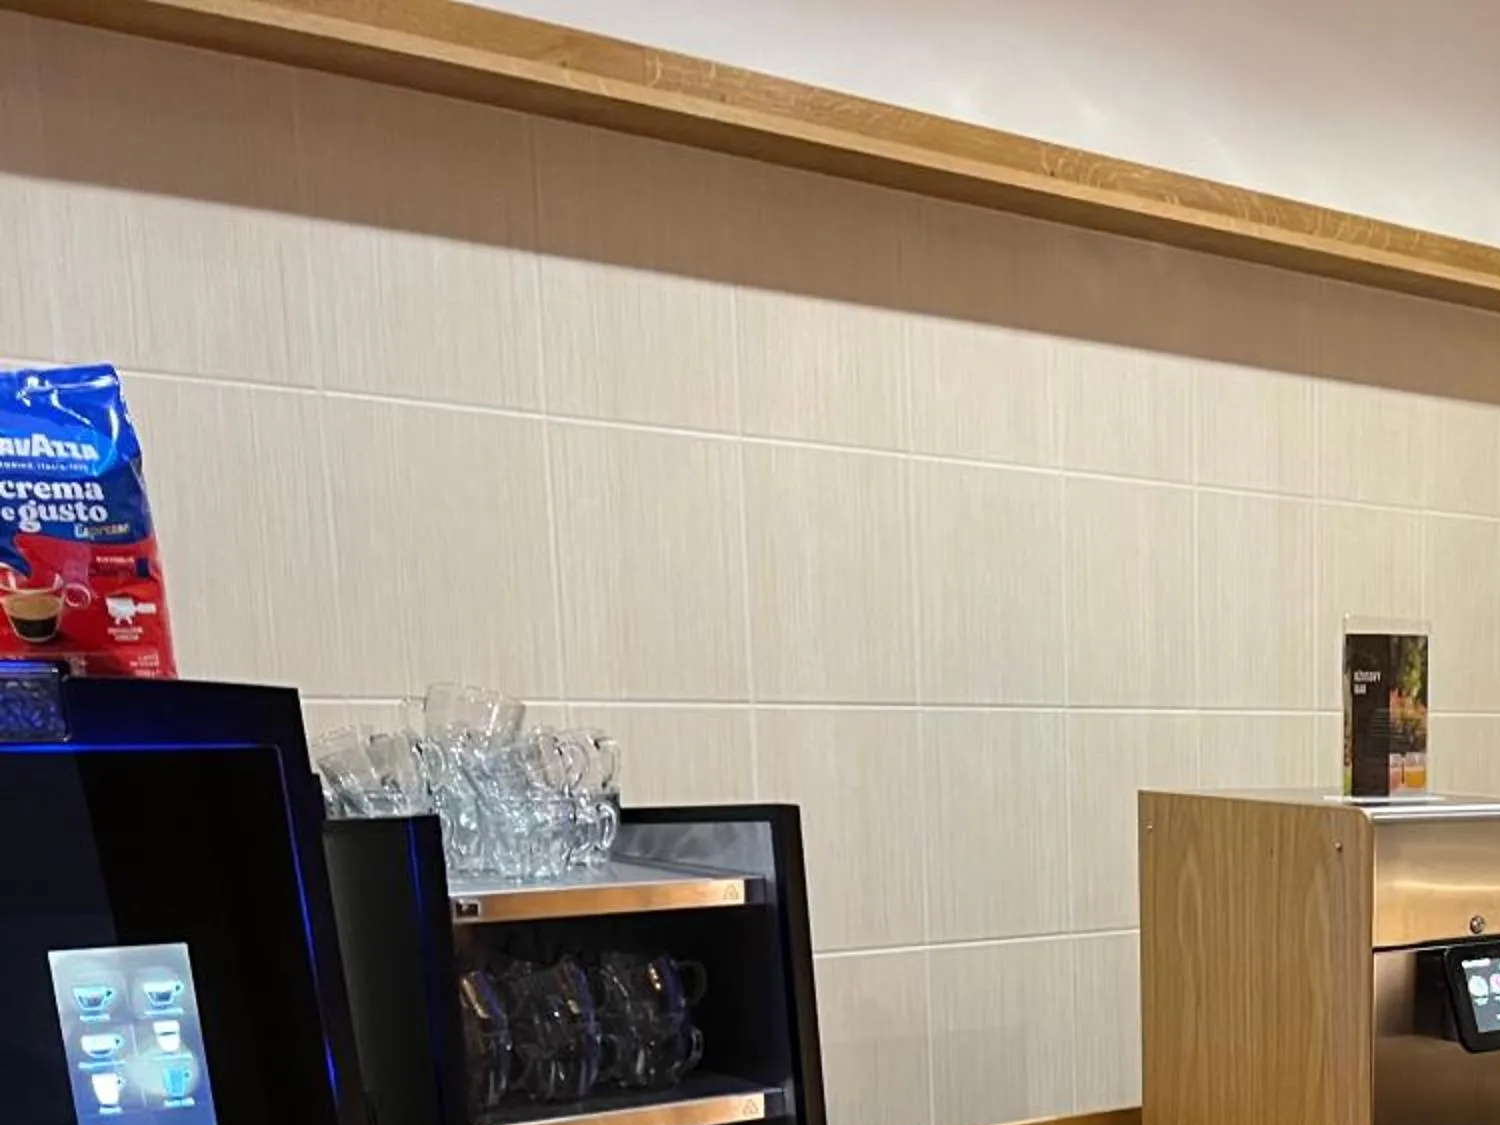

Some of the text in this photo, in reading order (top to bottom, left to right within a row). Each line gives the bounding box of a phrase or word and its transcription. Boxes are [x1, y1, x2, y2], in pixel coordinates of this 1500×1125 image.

[0, 433, 99, 461] AVAZZA
[0, 480, 104, 500] crema
[1, 500, 107, 533] e gusto
